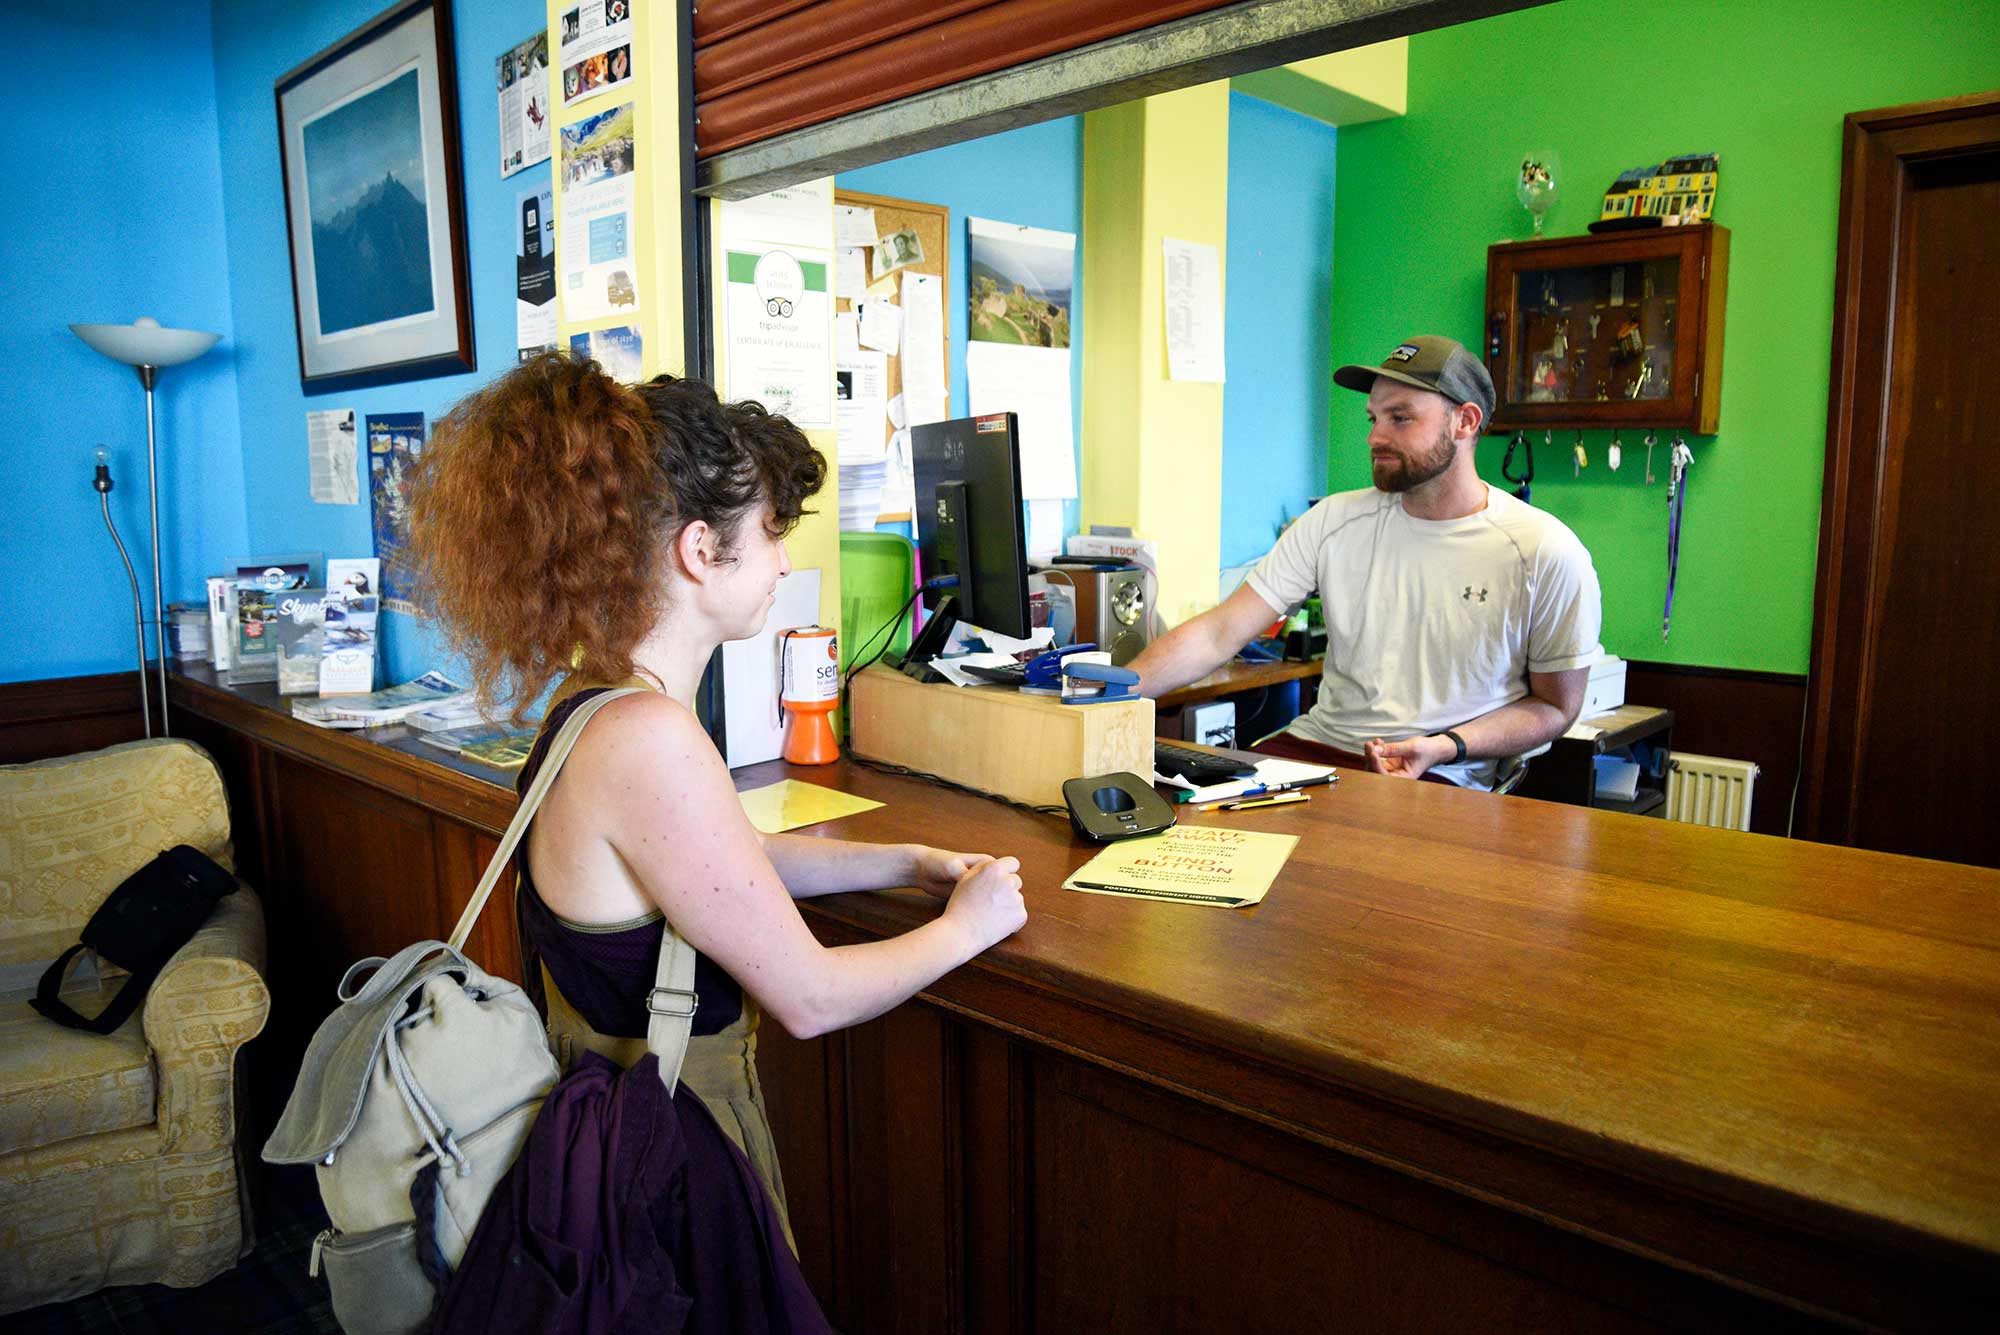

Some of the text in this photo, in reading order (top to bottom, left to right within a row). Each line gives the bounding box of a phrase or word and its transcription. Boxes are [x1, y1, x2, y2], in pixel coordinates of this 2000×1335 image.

[1176, 828, 1247, 837] STAFF
[1167, 834, 1247, 844] AWAY?
[1133, 859, 1233, 874] BUTTON
[1103, 885, 1137, 893] PORTREE
[1136, 888, 1189, 898] INDEPENDENT
